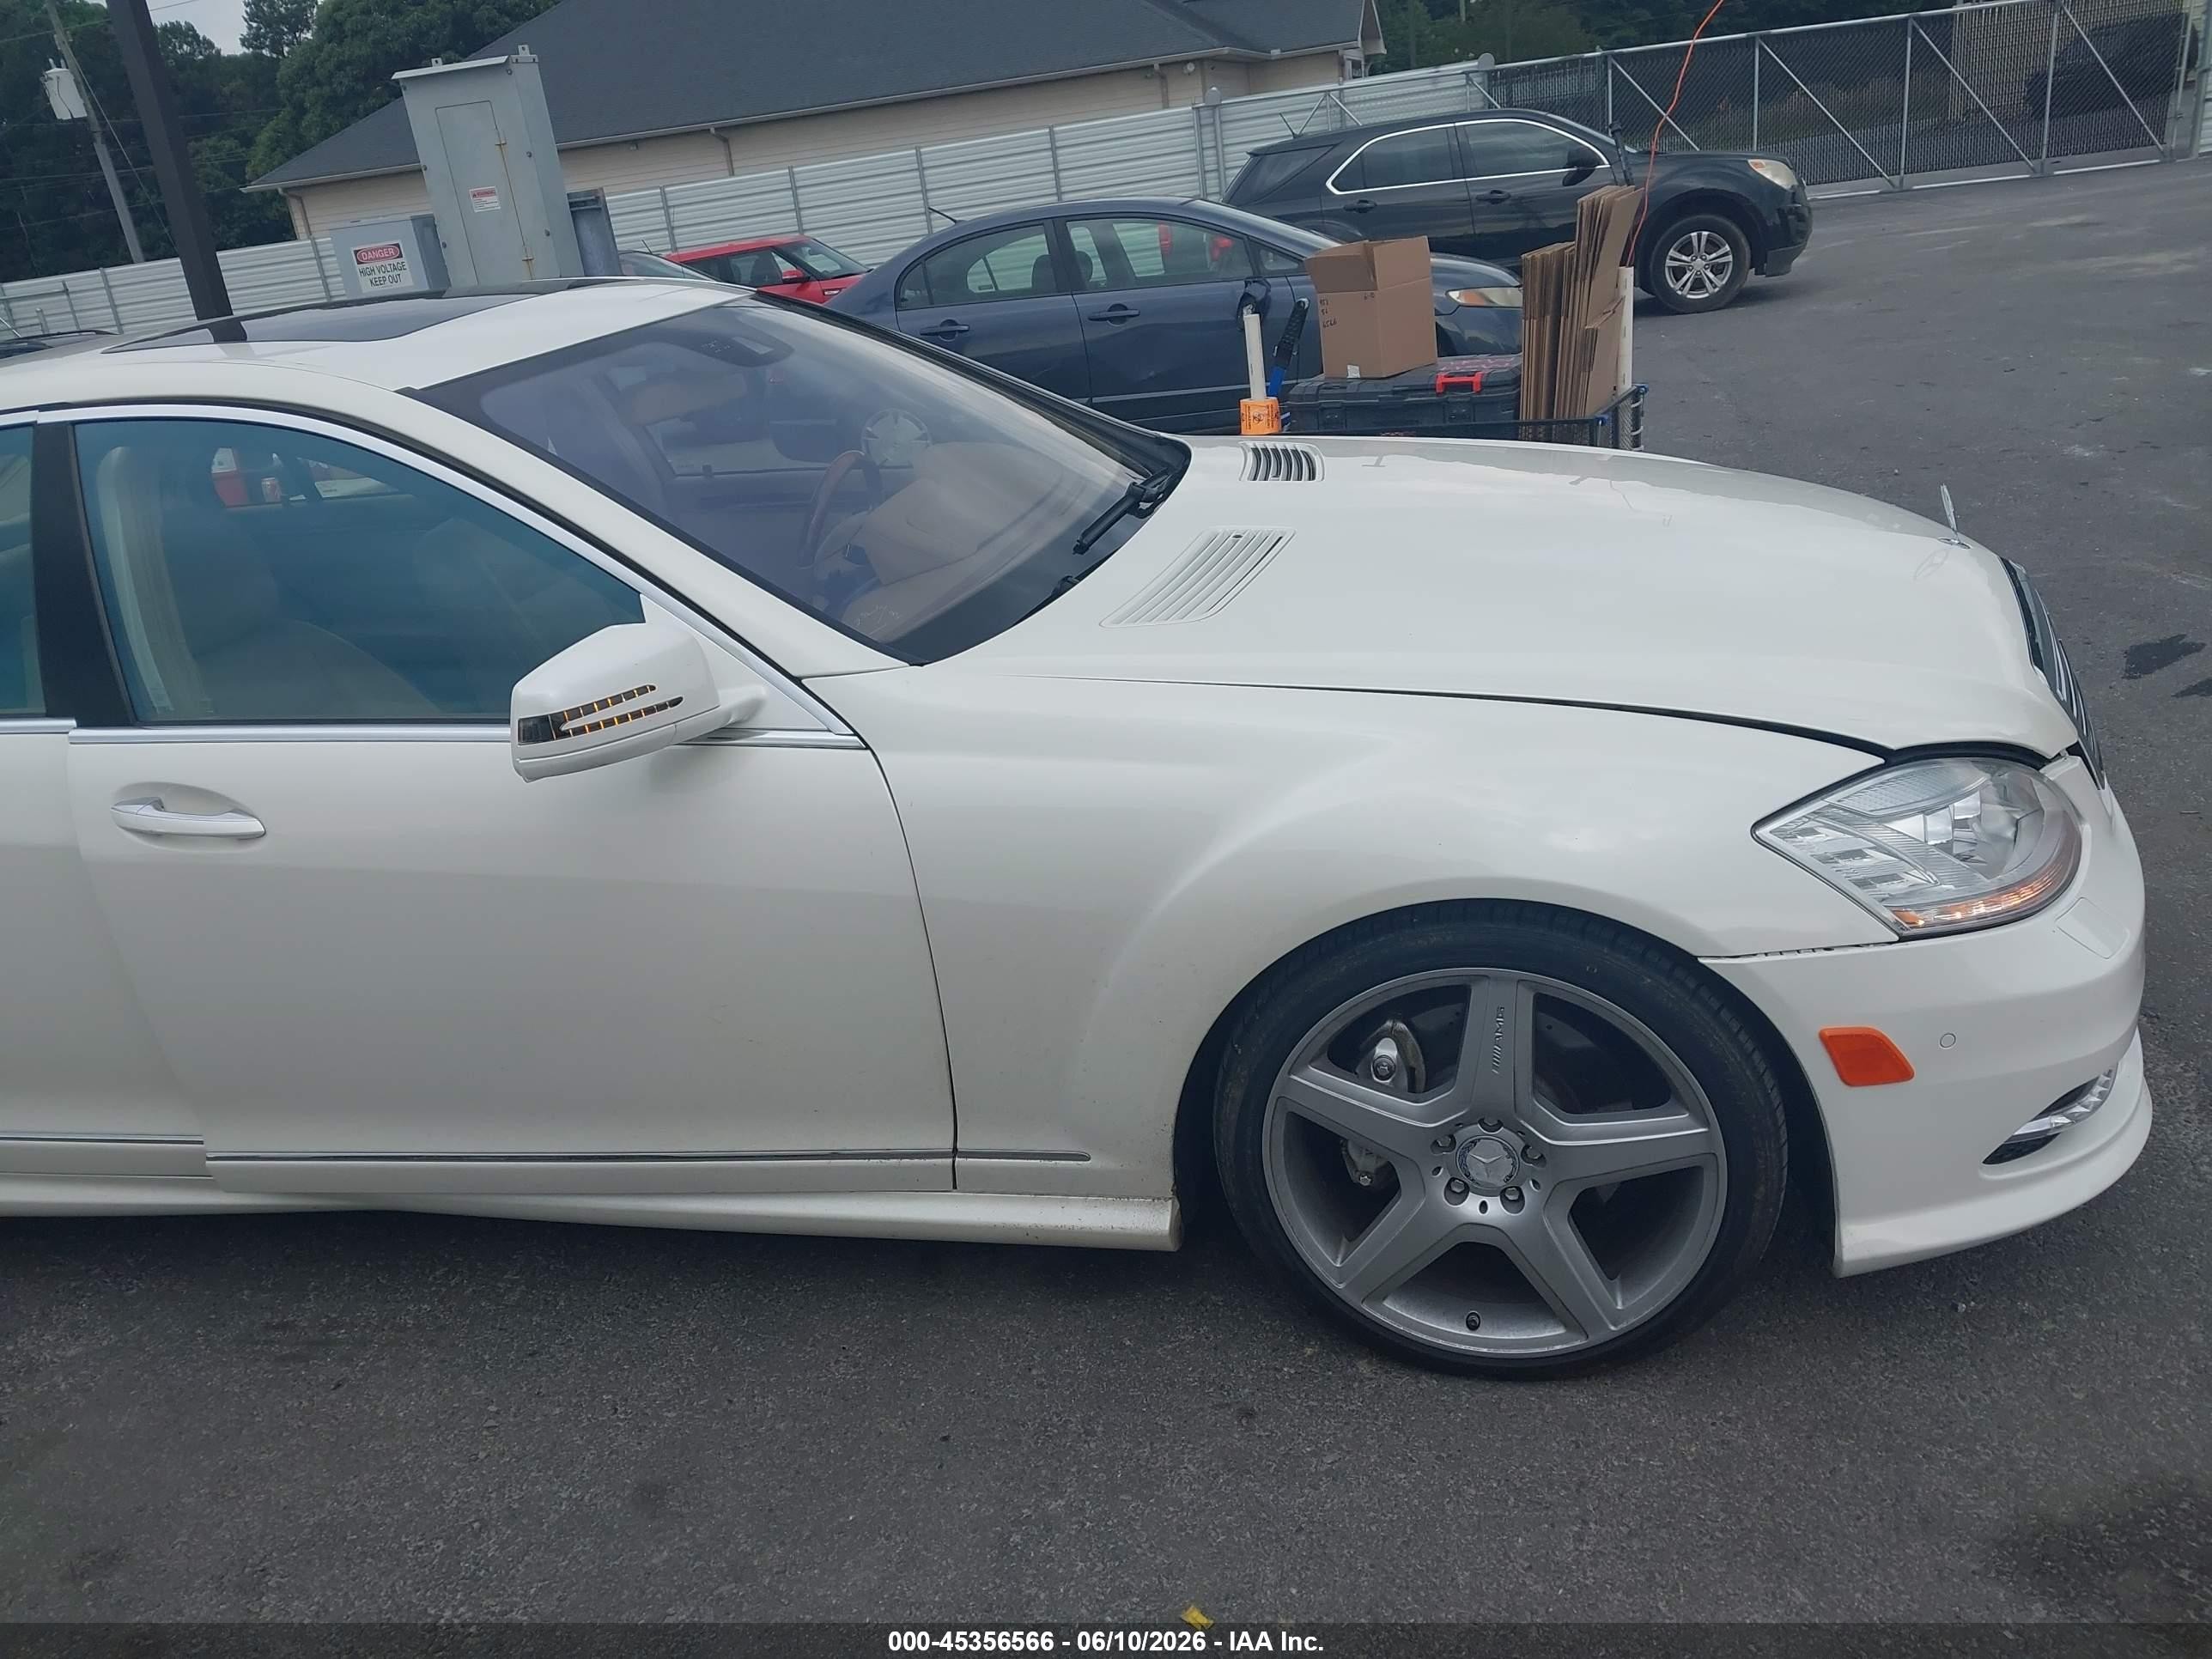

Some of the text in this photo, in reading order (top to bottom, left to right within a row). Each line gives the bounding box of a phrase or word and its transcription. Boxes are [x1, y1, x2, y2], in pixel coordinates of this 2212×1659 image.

[361, 247, 396, 261] DANGER
[358, 261, 407, 277] HIGH VOLTAGE
[369, 273, 402, 288] KEEP OUT
